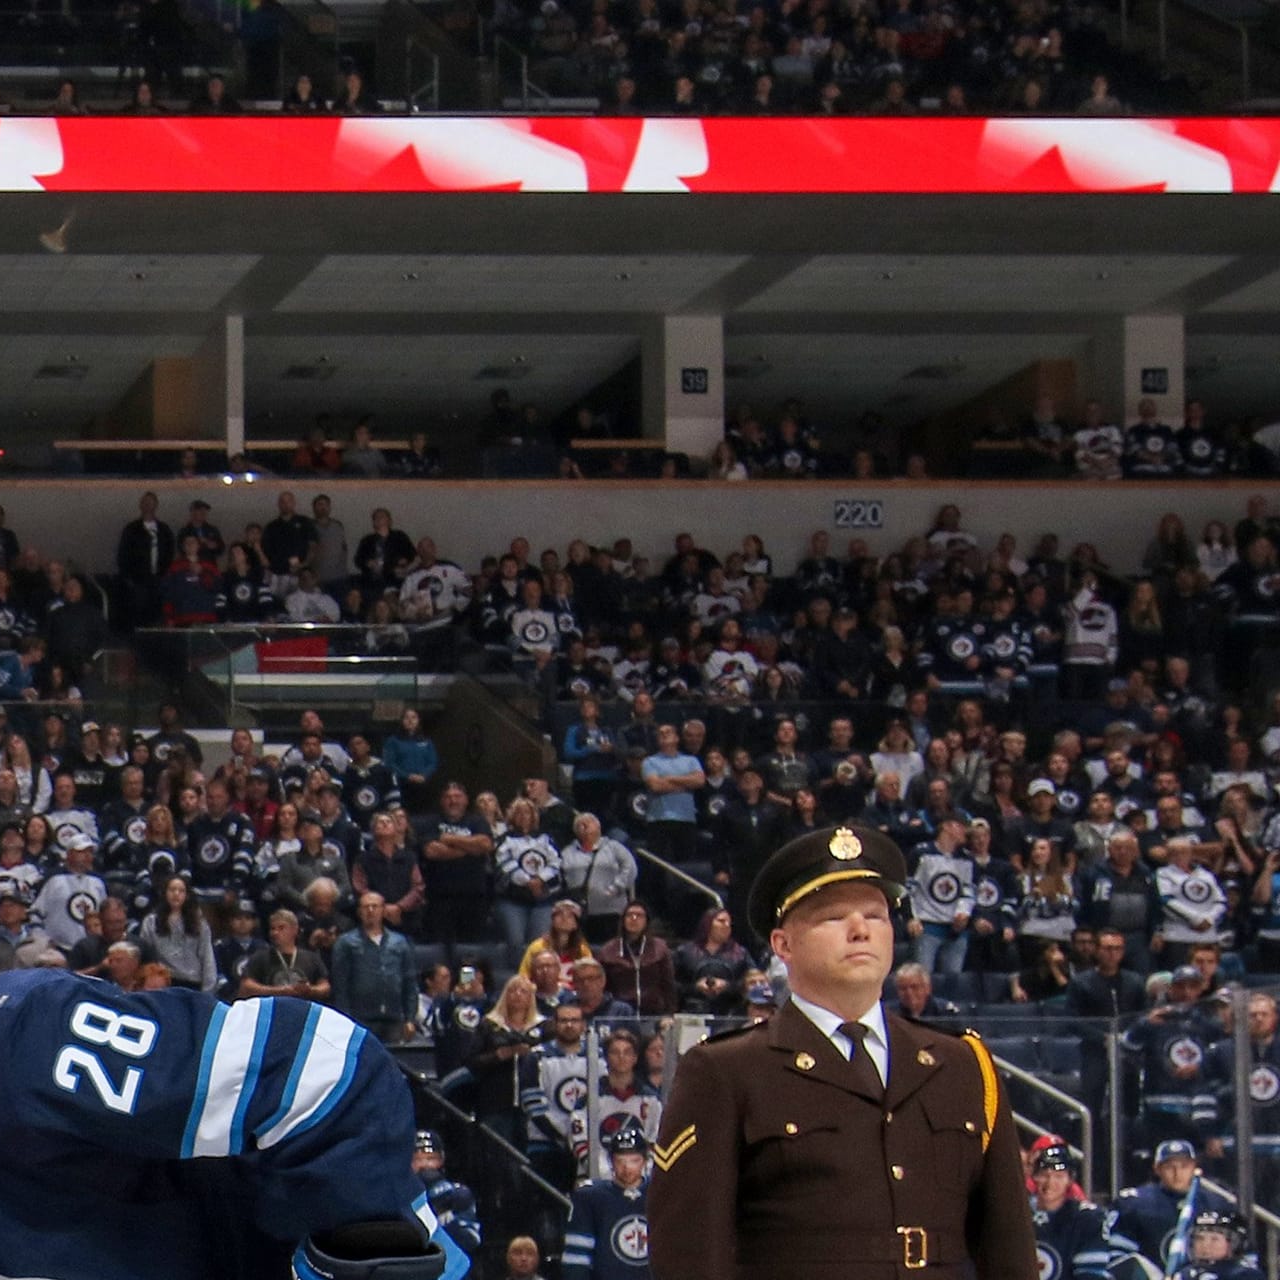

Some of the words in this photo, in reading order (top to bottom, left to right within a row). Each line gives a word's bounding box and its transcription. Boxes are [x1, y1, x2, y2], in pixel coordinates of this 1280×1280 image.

[684, 371, 706, 390] 39
[835, 502, 883, 527] 220
[53, 1002, 159, 1115] 28
